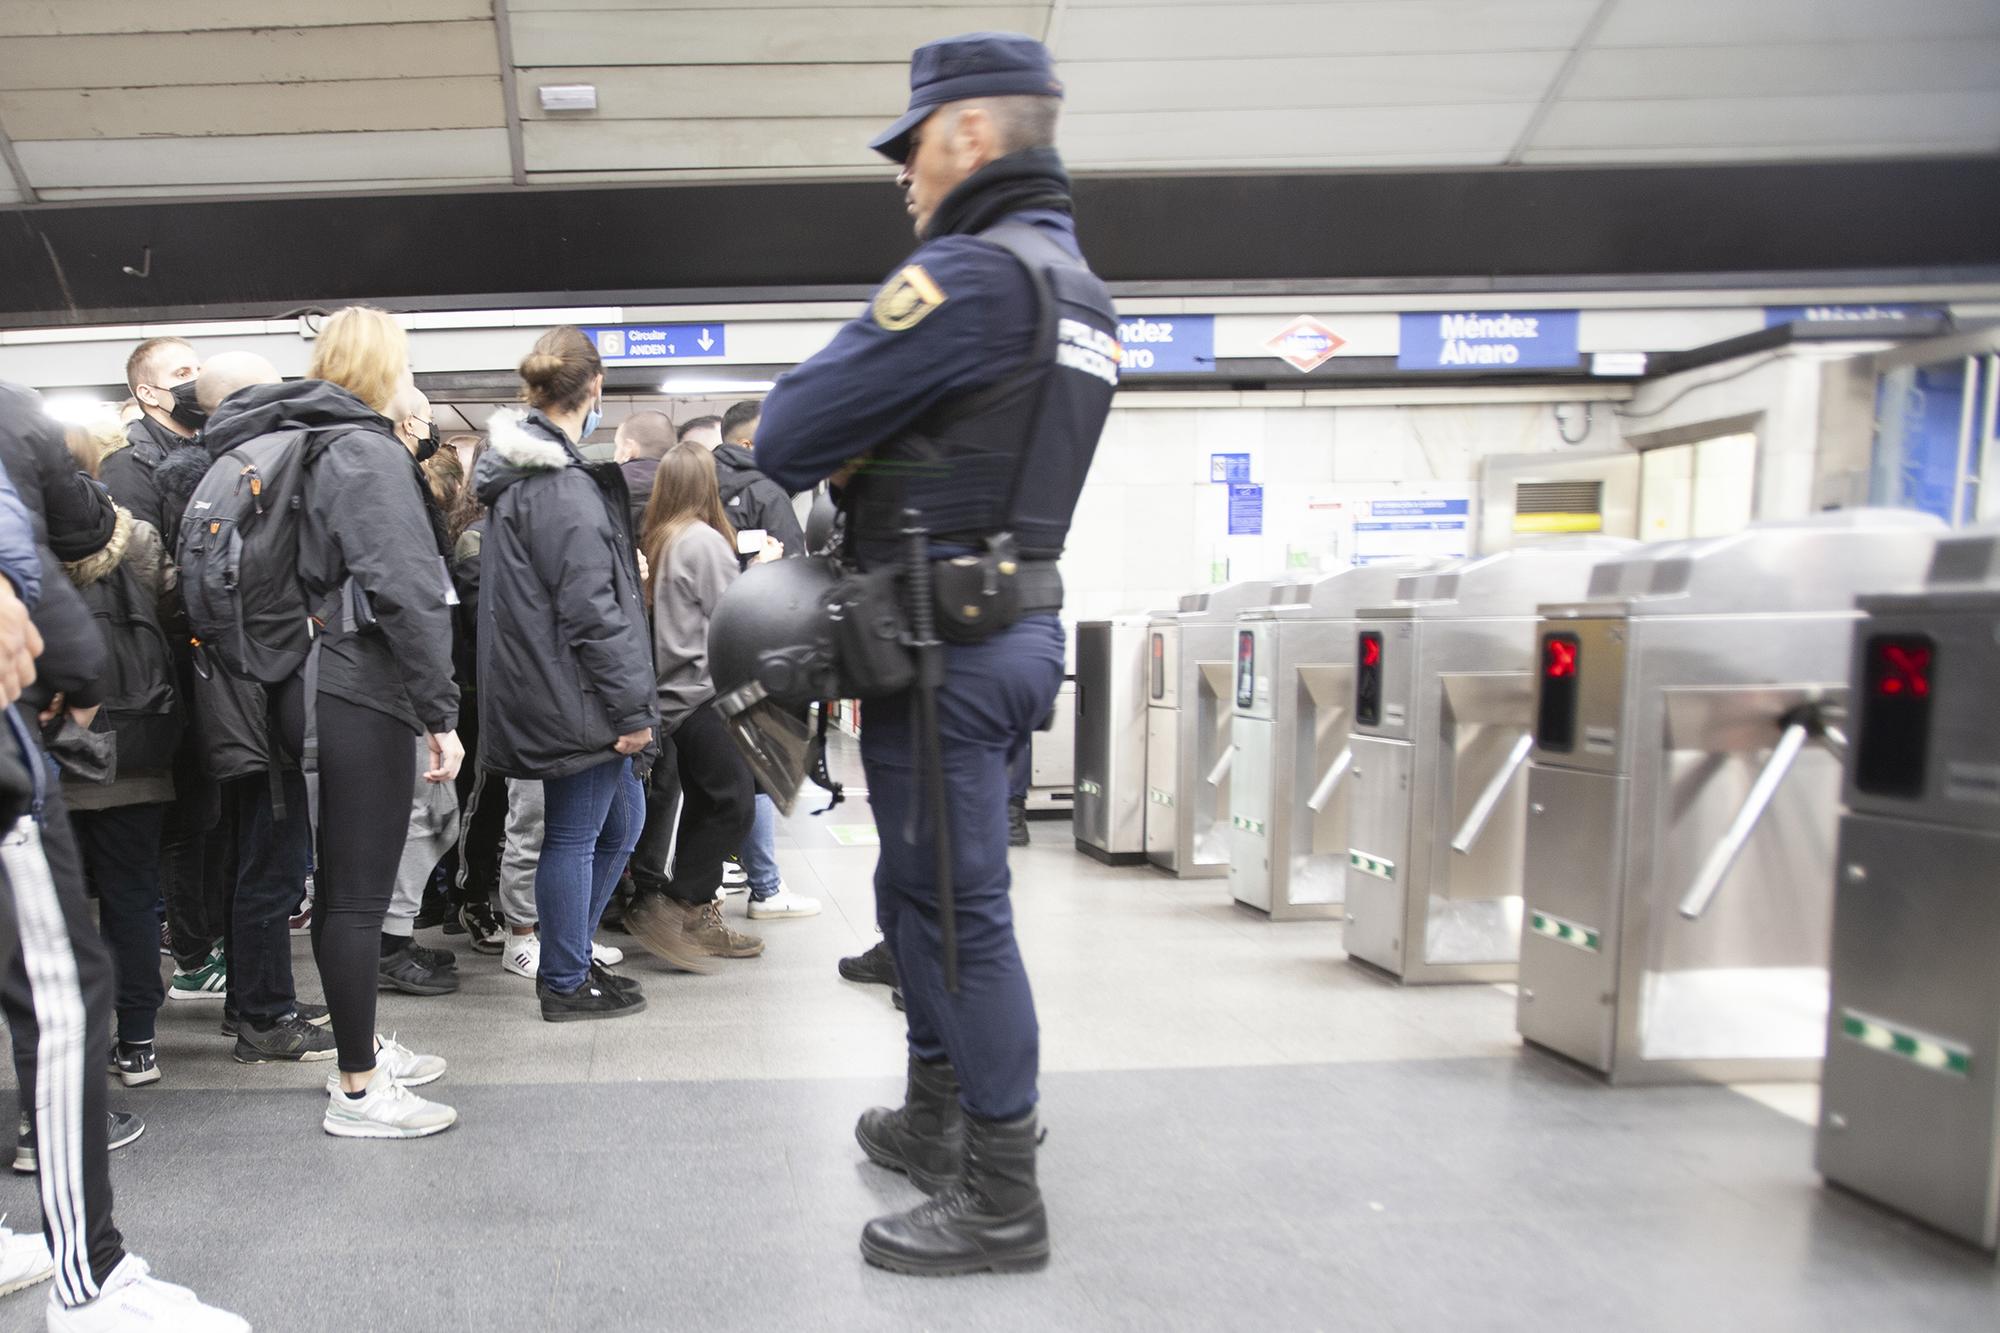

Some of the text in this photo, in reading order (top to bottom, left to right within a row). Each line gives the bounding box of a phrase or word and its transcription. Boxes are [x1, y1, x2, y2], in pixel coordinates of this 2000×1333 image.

[628, 330, 667, 340] Circular
[1117, 318, 1173, 342] ndez
[1440, 313, 1539, 338] Méndez
[604, 334, 619, 353] 6
[629, 344, 675, 355] ANDEN 1
[1440, 339, 1520, 365] Álvaro
[1119, 348, 1154, 368] aro
